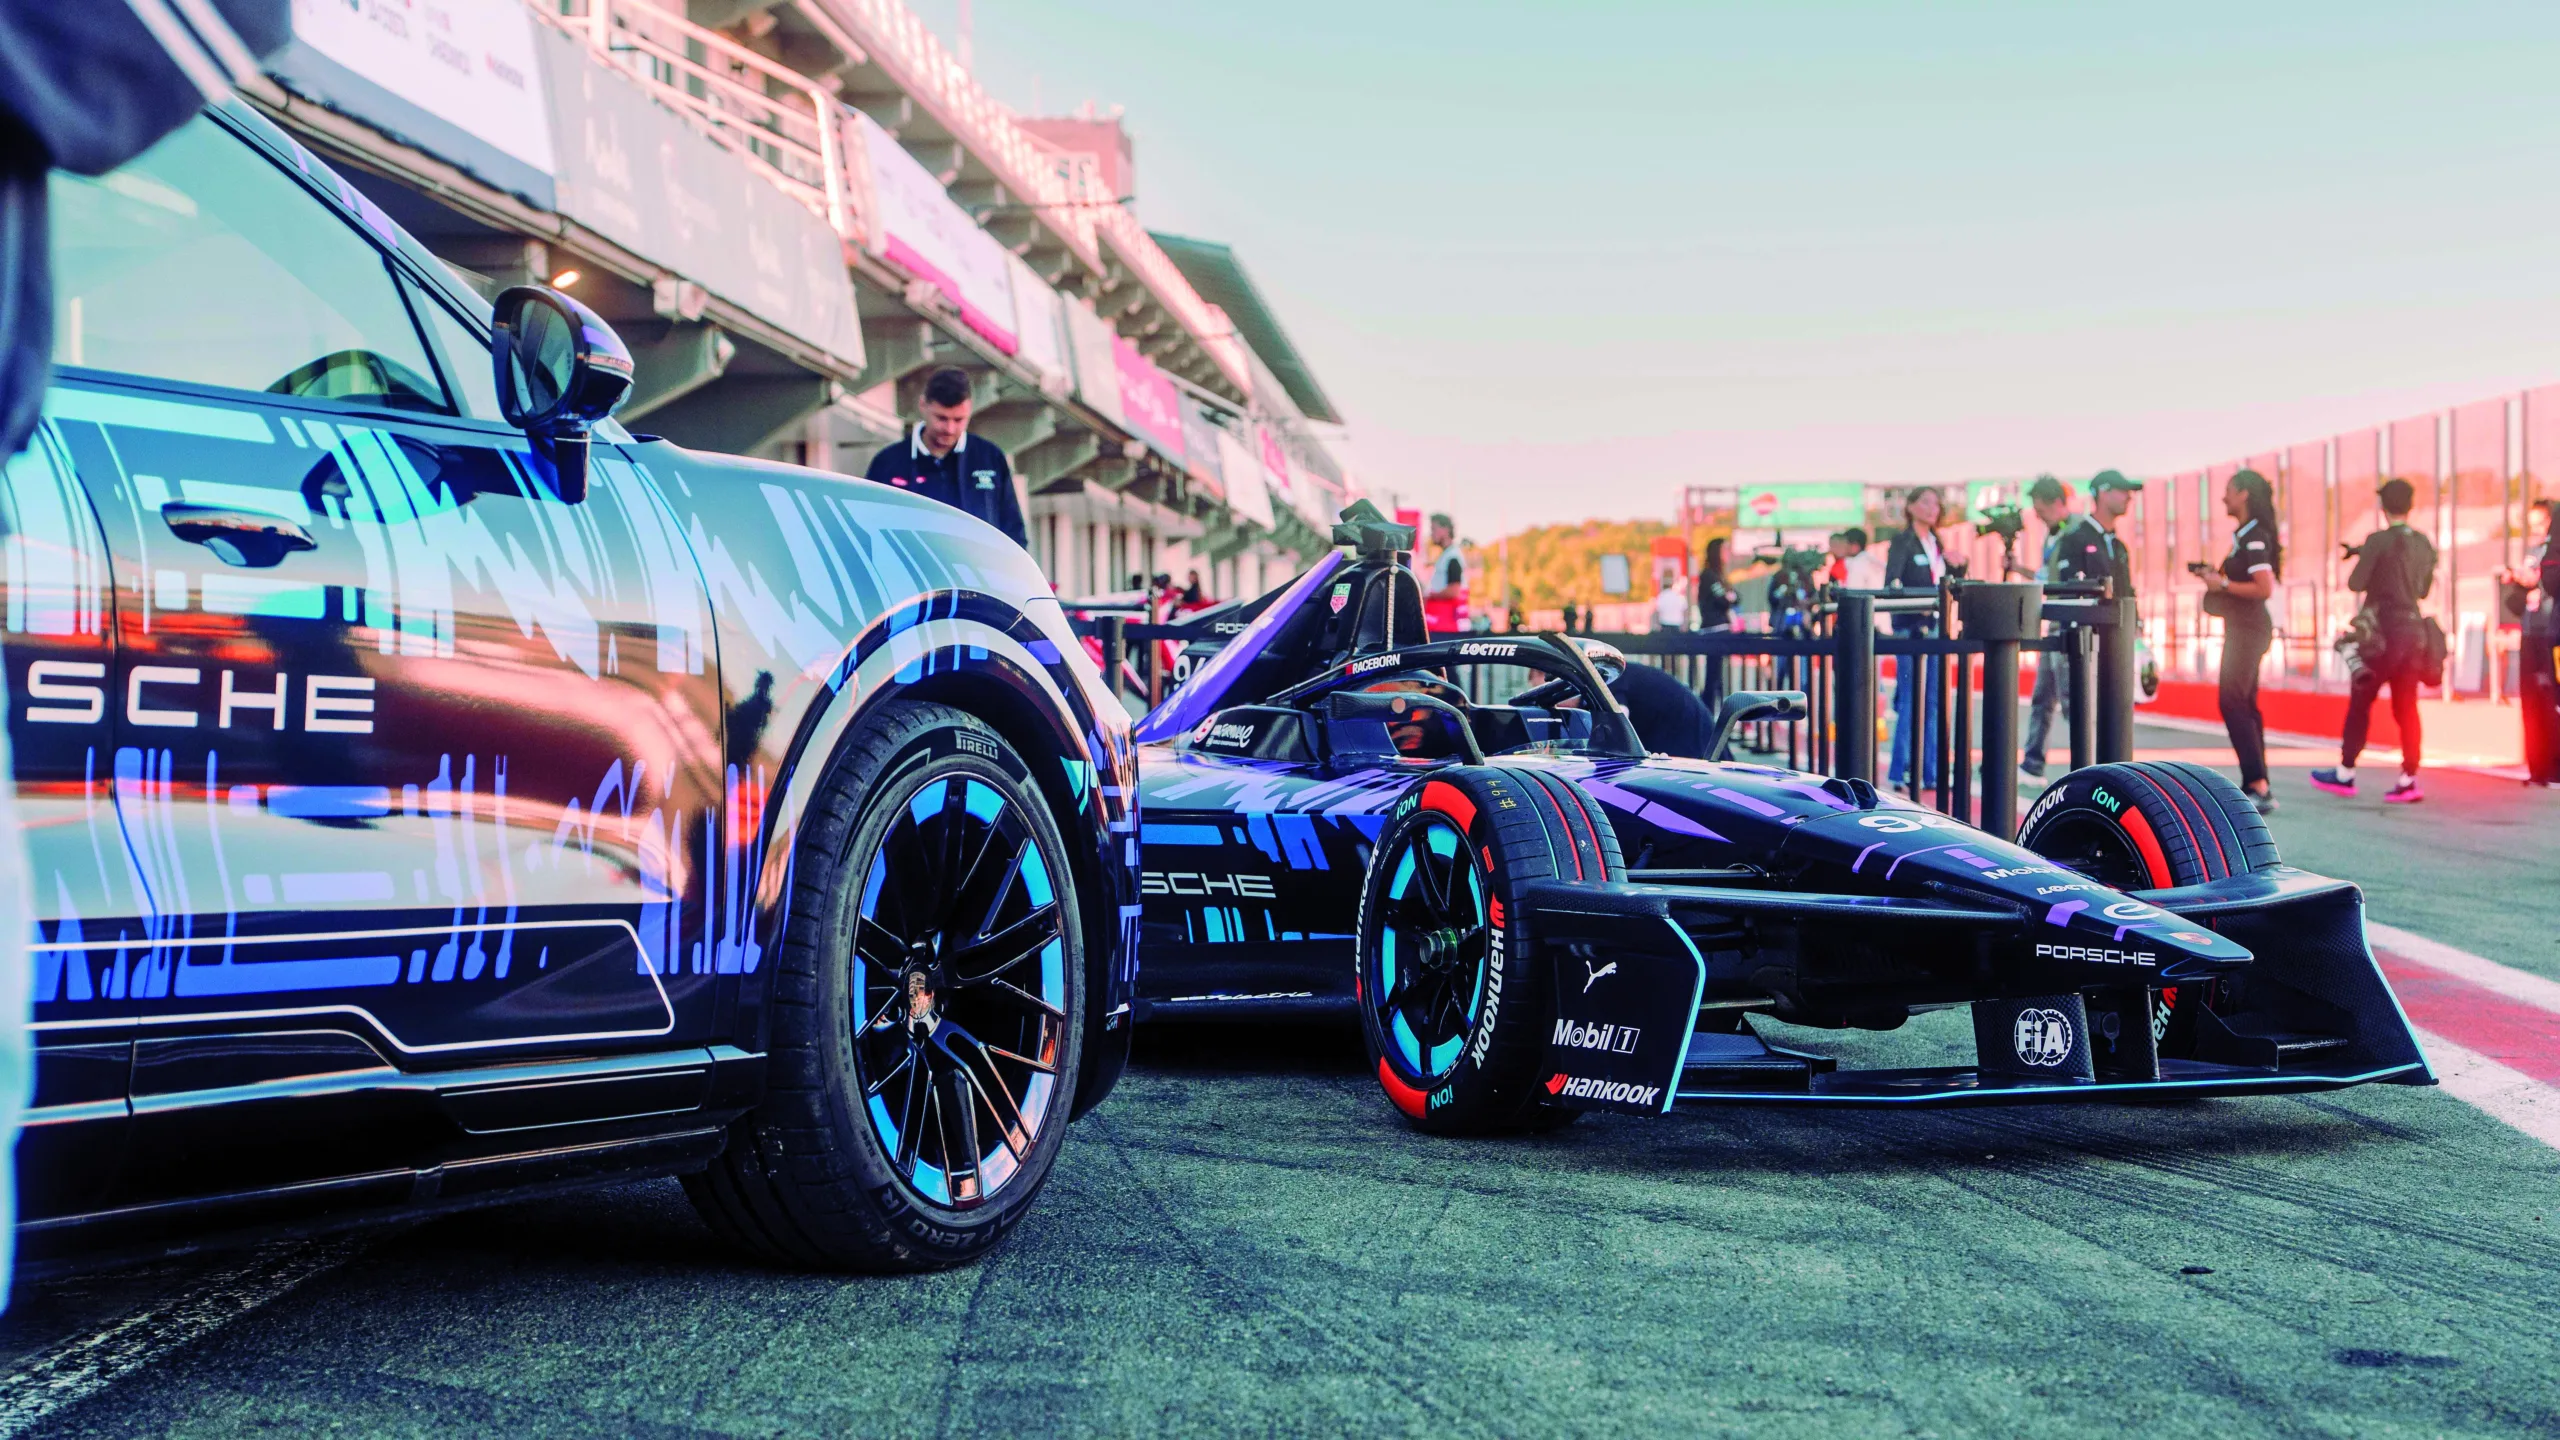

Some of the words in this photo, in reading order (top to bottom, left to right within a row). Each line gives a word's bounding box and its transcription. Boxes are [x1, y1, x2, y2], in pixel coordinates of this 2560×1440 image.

[1352, 653, 1400, 674] RACEBORN
[1459, 643, 1518, 657] LOCTITE
[26, 660, 376, 734] SCHE
[953, 729, 999, 760] PIRELLI
[1142, 872, 1276, 898] SCHE
[2036, 943, 2156, 967] PORSCHE
[1552, 1018, 1615, 1050] Mobil
[908, 1218, 977, 1248] ZERO
